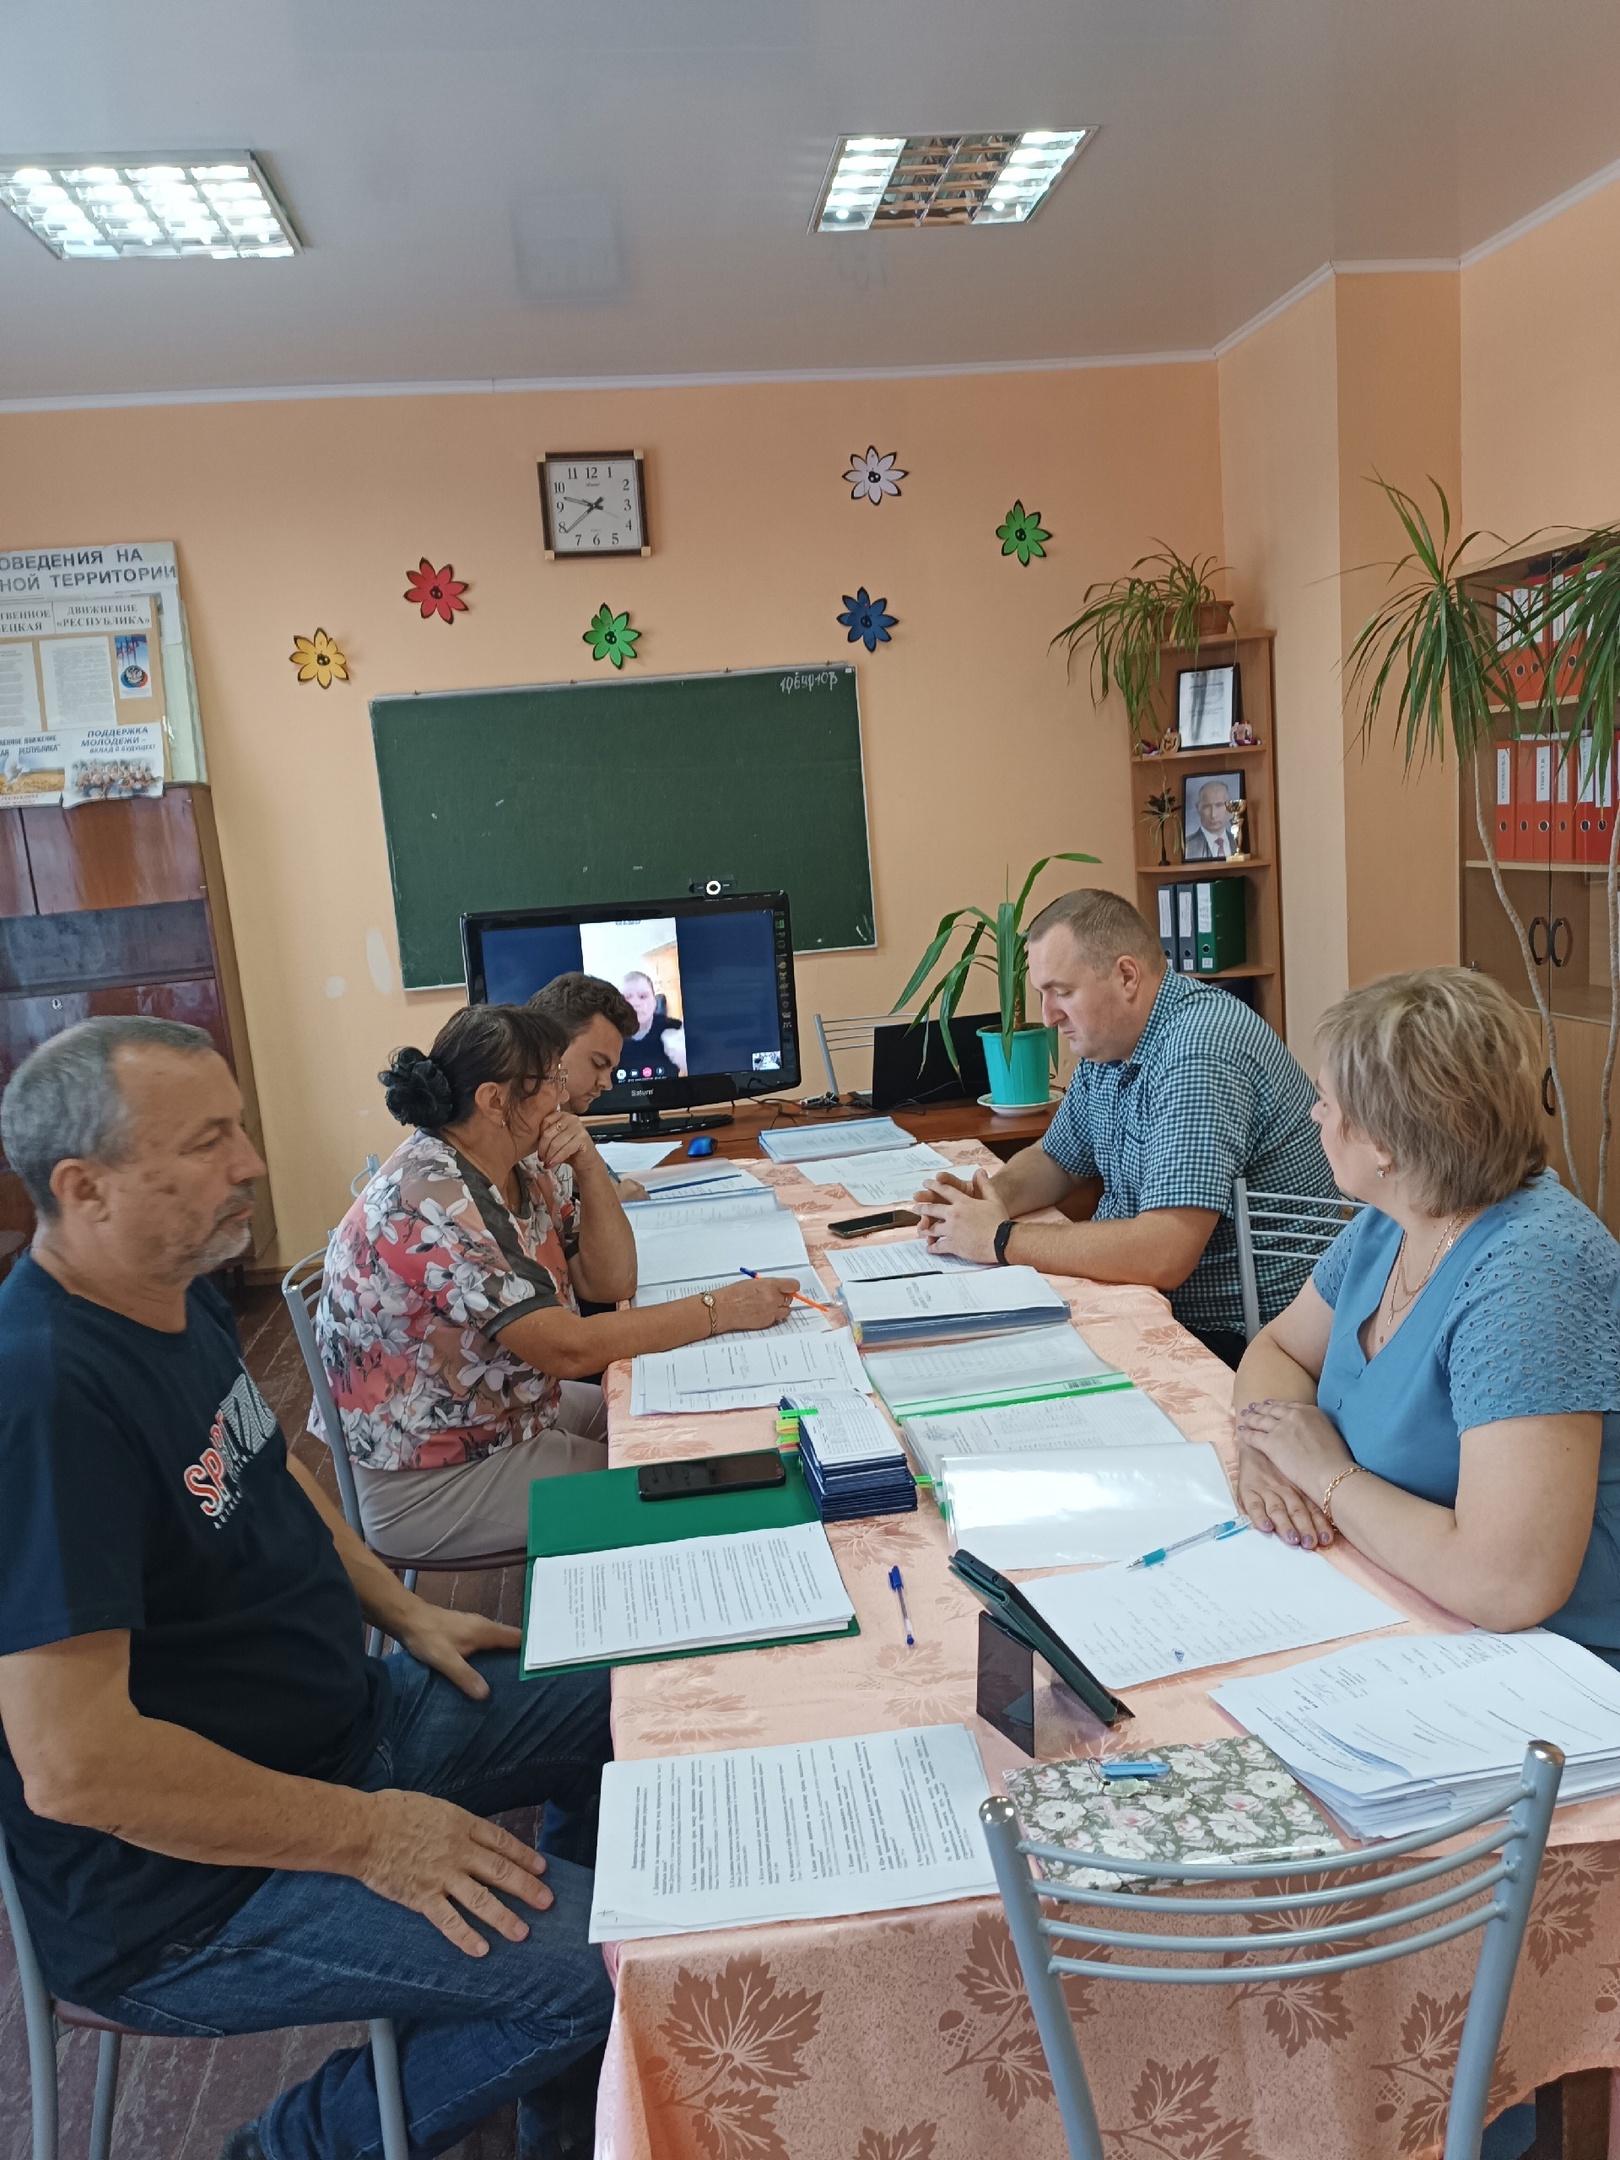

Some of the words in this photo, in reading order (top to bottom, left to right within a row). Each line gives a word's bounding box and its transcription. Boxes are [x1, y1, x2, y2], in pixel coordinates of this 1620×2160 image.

[568, 467, 578, 479] 11
[586, 467, 598, 479] 12
[608, 466, 613, 478] 1
[554, 481, 565, 494] 10
[622, 479, 630, 491] 2
[557, 501, 564, 513] 9
[624, 499, 631, 511] 3
[558, 521, 567, 533] 8
[625, 518, 632, 531] 4
[575, 534, 582, 546] 7
[593, 533, 601, 546] 6
[612, 532, 620, 545] 5
[0, 550, 103, 571] ОВЕДЕНИЯ
[116, 548, 143, 563] НА
[0, 573, 40, 592] НОЙ
[49, 566, 177, 588] ТЕРРИТОРИИ
[87, 726, 148, 738] ПОДДЕРЖКА
[81, 736, 139, 747] МОЛОДЕЖИ
